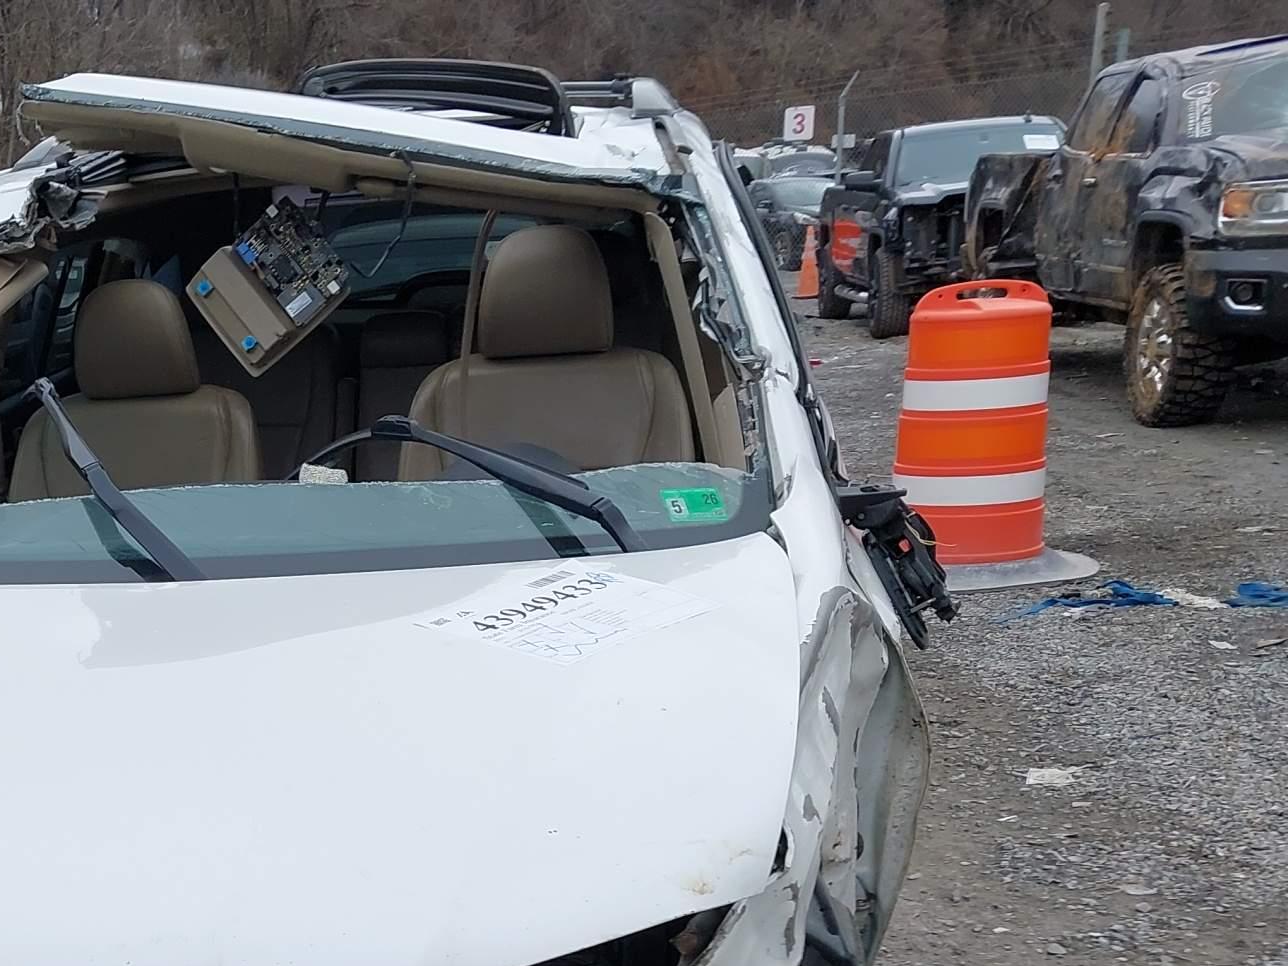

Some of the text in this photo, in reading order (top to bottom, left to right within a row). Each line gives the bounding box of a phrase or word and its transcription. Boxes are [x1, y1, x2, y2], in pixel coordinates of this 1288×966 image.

[792, 113, 806, 134] 3
[671, 500, 683, 514] 5
[701, 493, 719, 505] 26
[472, 578, 608, 632] 43949433
